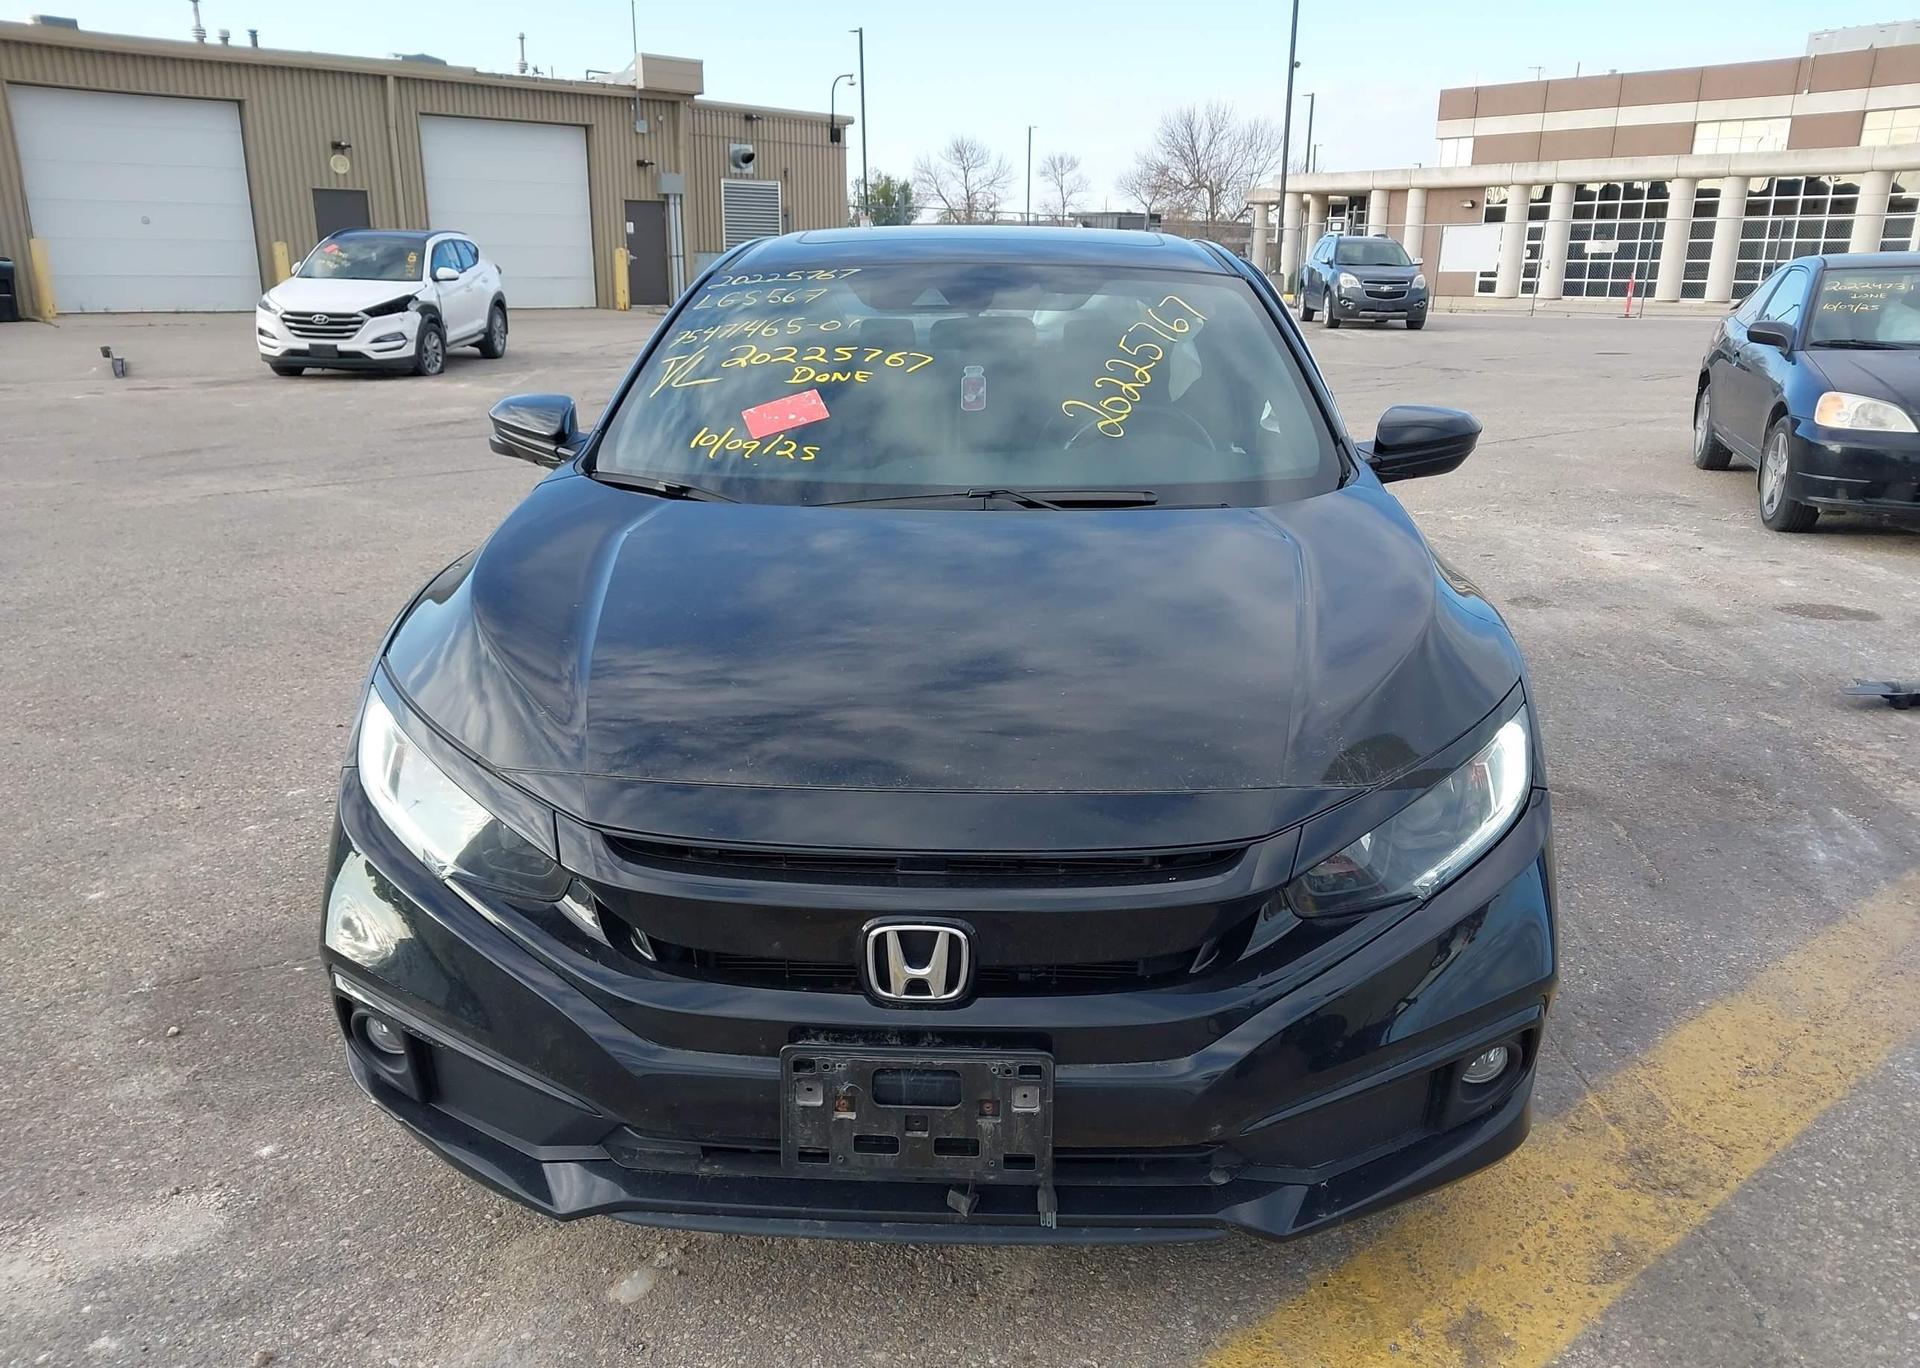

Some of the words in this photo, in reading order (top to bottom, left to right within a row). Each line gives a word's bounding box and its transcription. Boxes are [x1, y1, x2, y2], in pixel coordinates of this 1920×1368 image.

[707, 268, 862, 290] 20225767
[721, 344, 934, 374] 20225767
[1062, 295, 1208, 438] 20225767
[784, 366, 874, 384] DONE
[690, 427, 820, 461] 10/09/25
